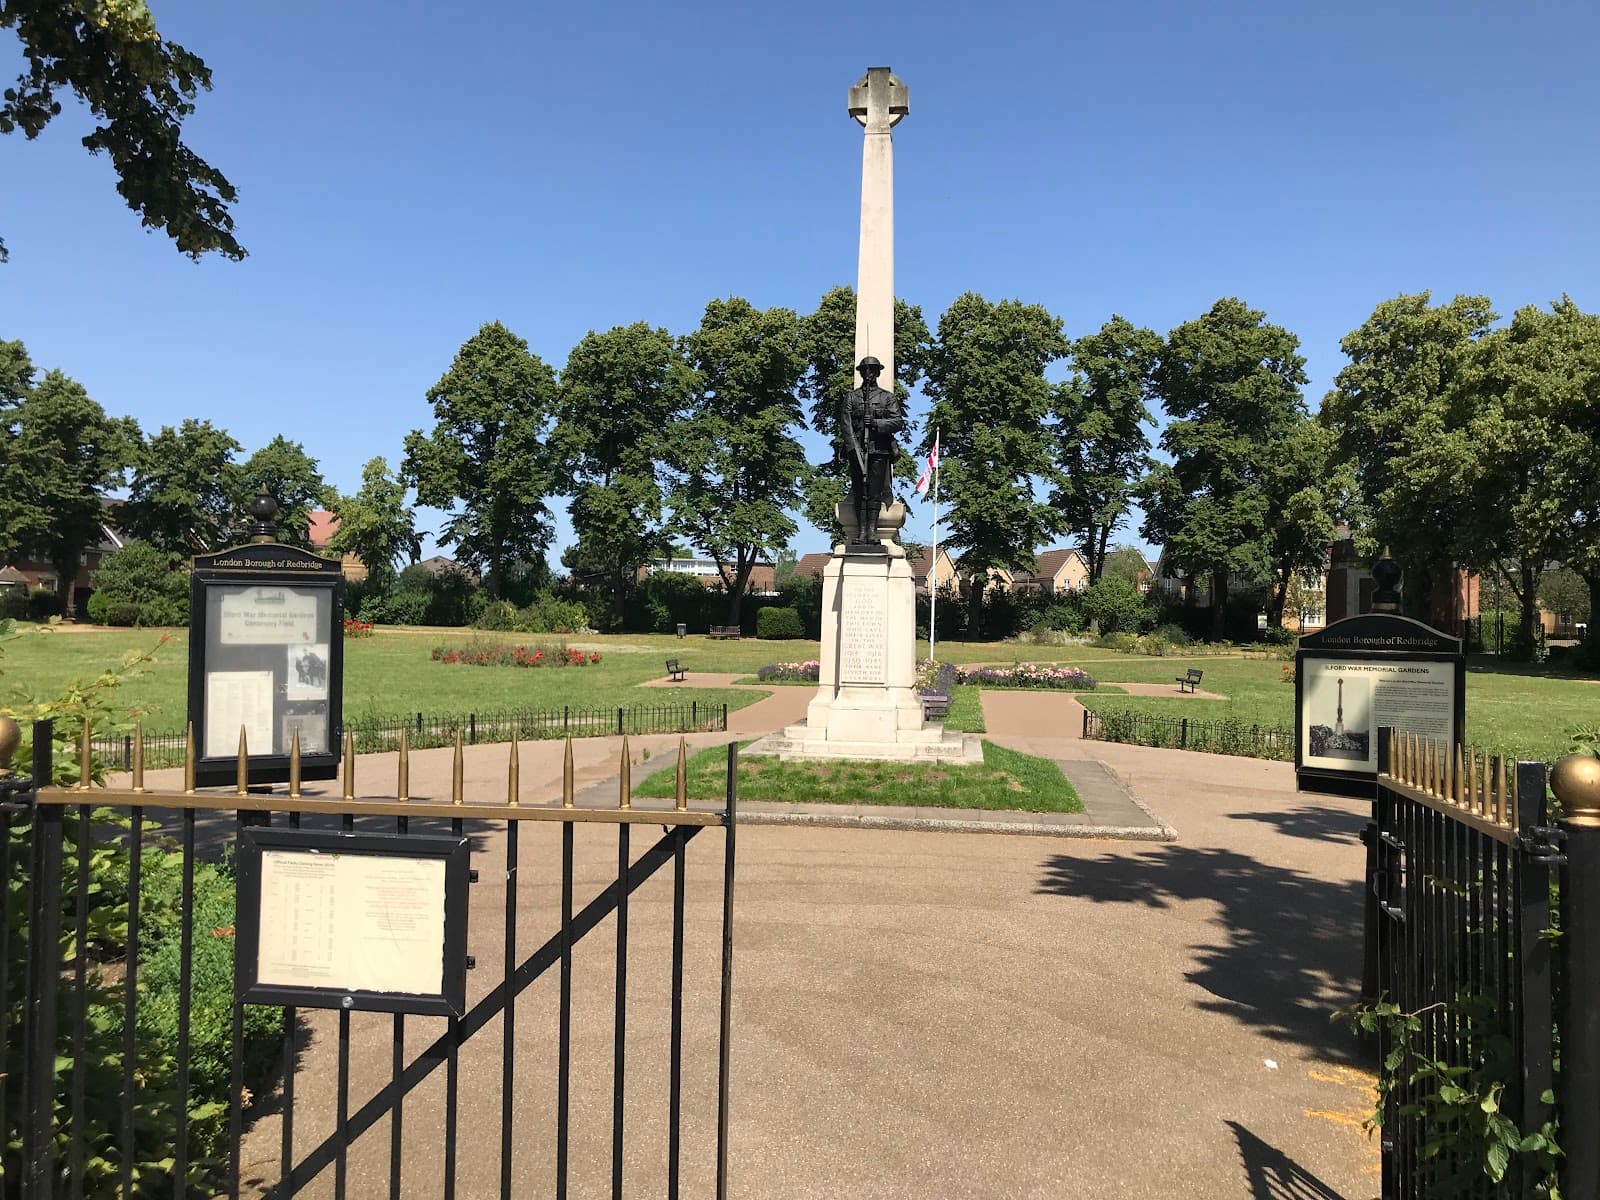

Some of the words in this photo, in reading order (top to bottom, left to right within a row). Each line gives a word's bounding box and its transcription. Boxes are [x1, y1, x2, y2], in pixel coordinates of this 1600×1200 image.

[212, 558, 243, 567] London
[244, 558, 277, 569] Borough
[277, 559, 285, 568] of
[286, 560, 323, 569] Redbridge
[1321, 636, 1350, 644] London
[1353, 636, 1385, 646] Borough
[1386, 636, 1395, 645] of
[1397, 637, 1438, 648] Redbridge
